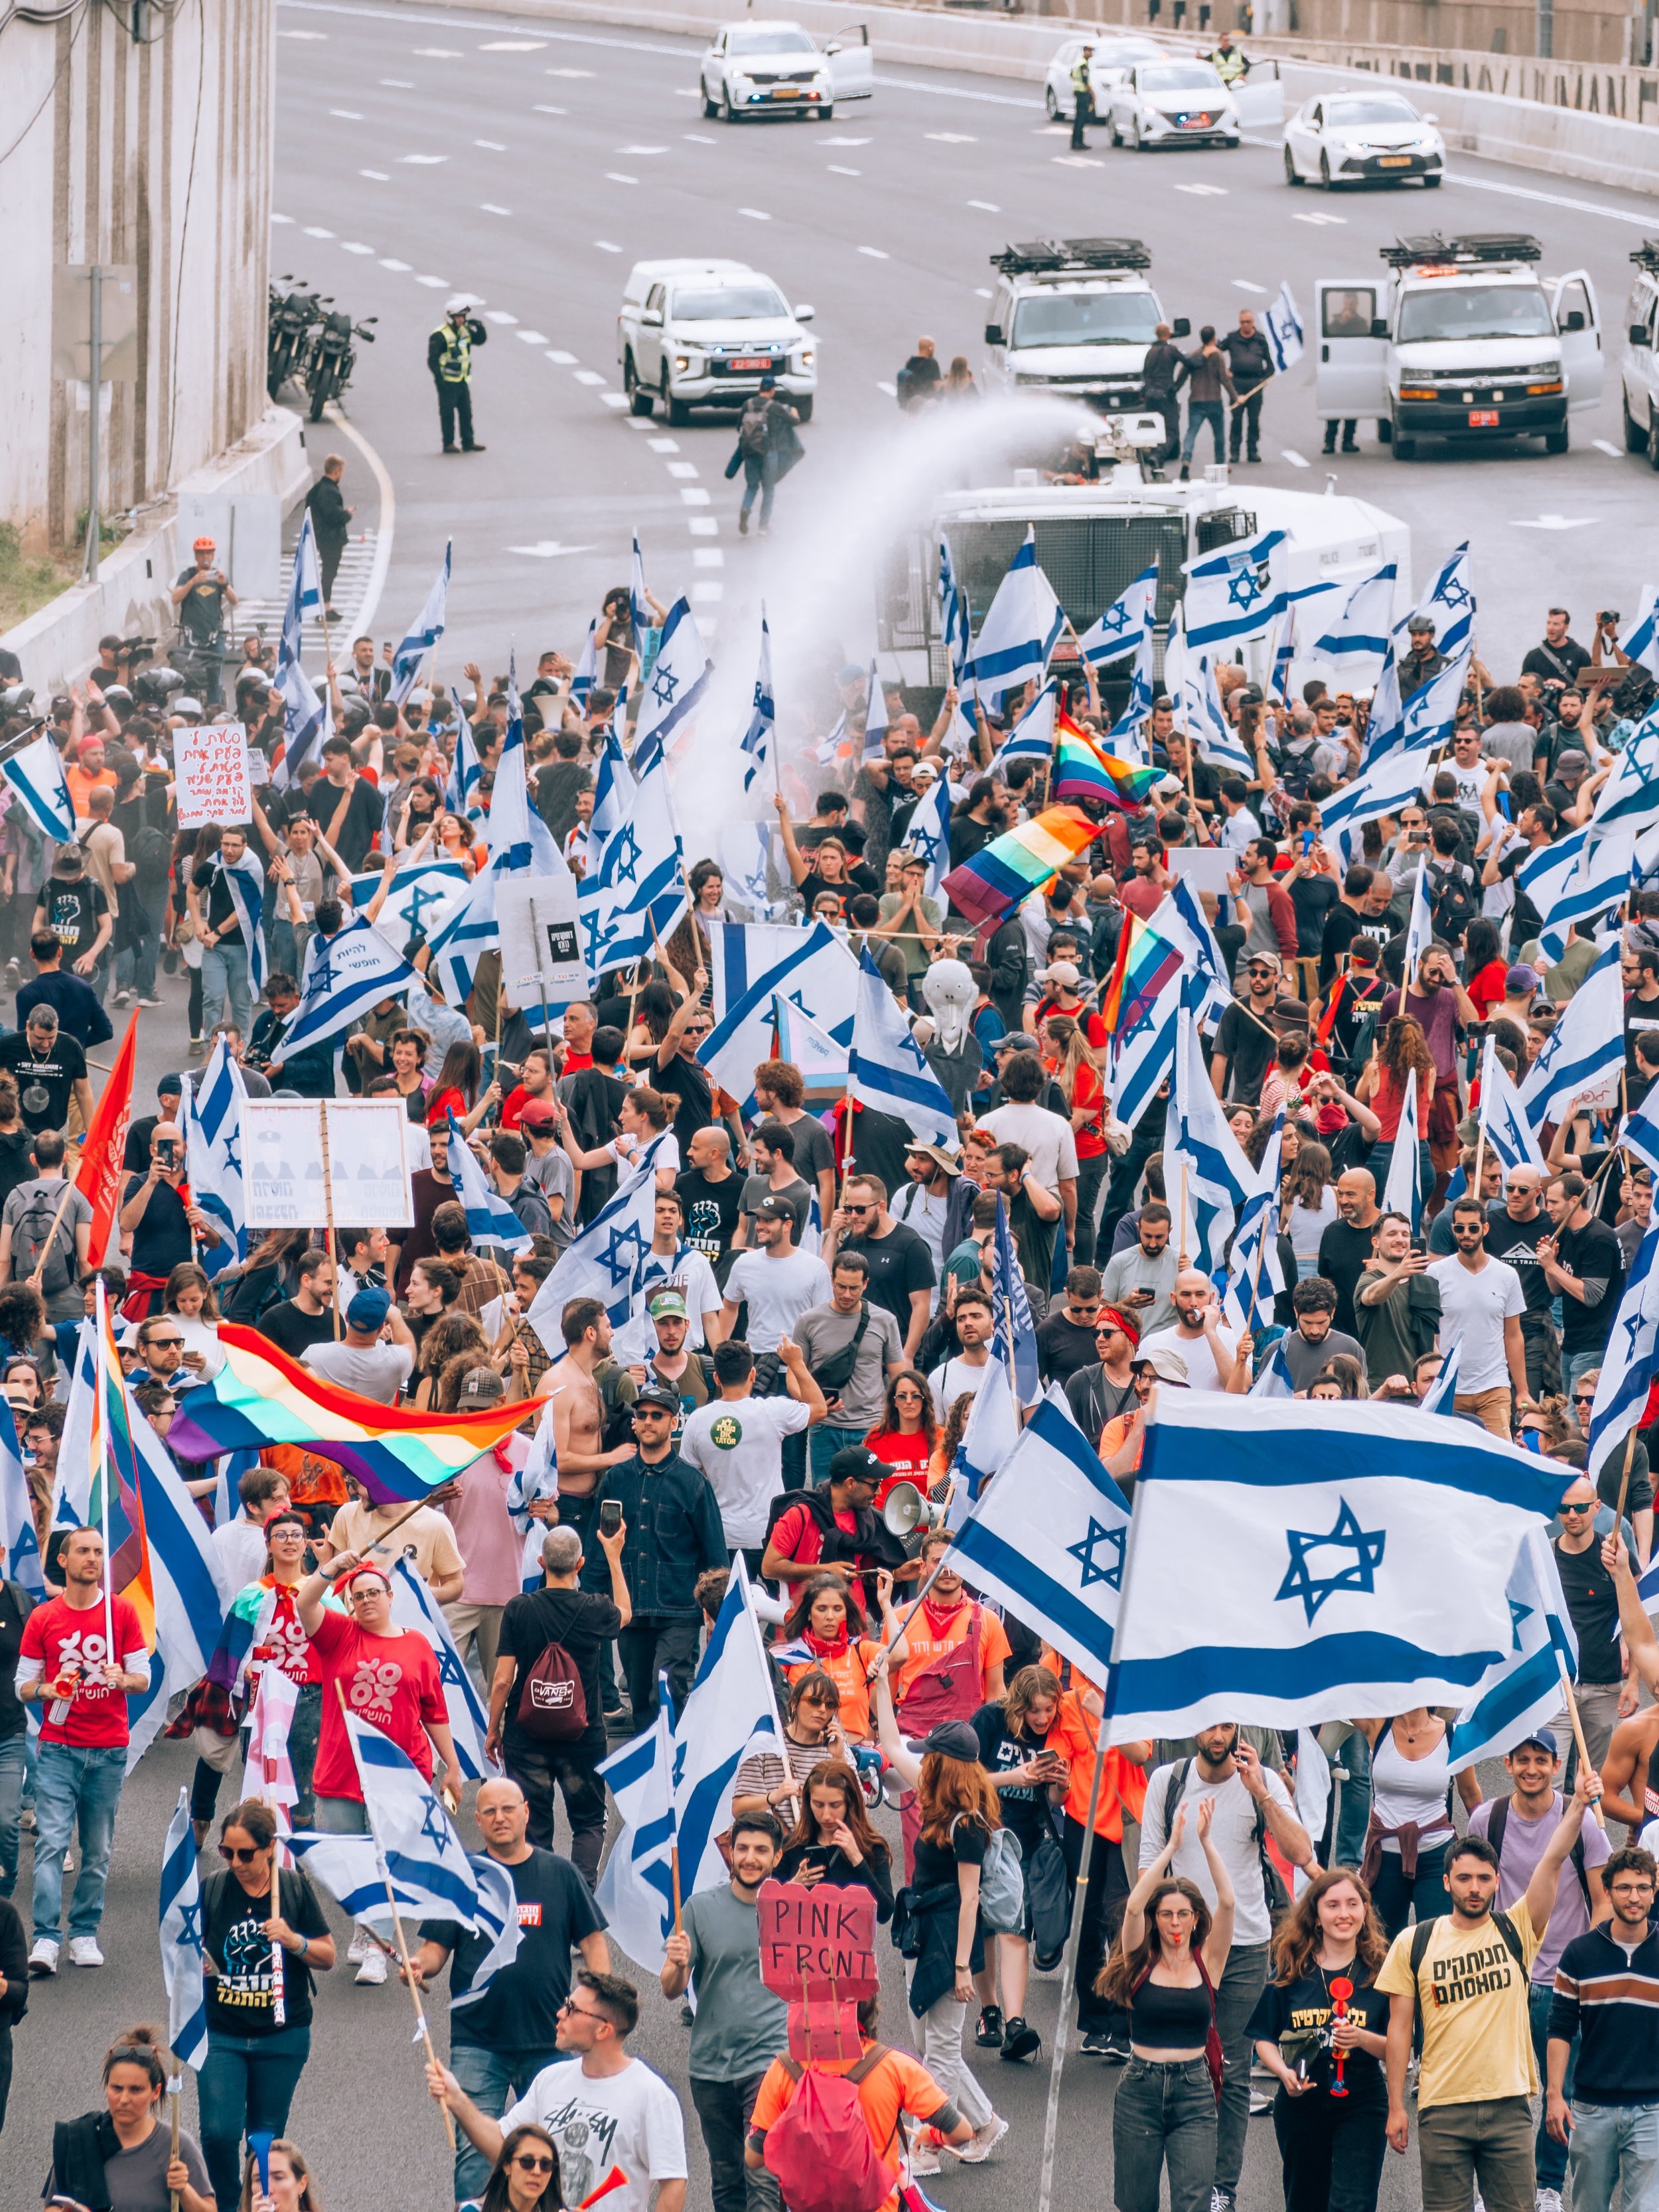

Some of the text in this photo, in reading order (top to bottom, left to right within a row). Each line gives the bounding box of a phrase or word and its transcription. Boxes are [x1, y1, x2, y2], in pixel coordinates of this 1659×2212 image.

[214, 745, 242, 760] פעם
[216, 772, 244, 786] פעם
[336, 943, 366, 961] להיות
[348, 957, 381, 969] חופשי
[715, 1436, 737, 1445] TATOR
[540, 1686, 567, 1696] VANS
[776, 1899, 859, 1941] PINK
[772, 1942, 874, 1980] FRONT
[1433, 1943, 1509, 1982] מנותקים
[1431, 1968, 1512, 2008] נמאסתם!
[1346, 2008, 1367, 2028] בלי
